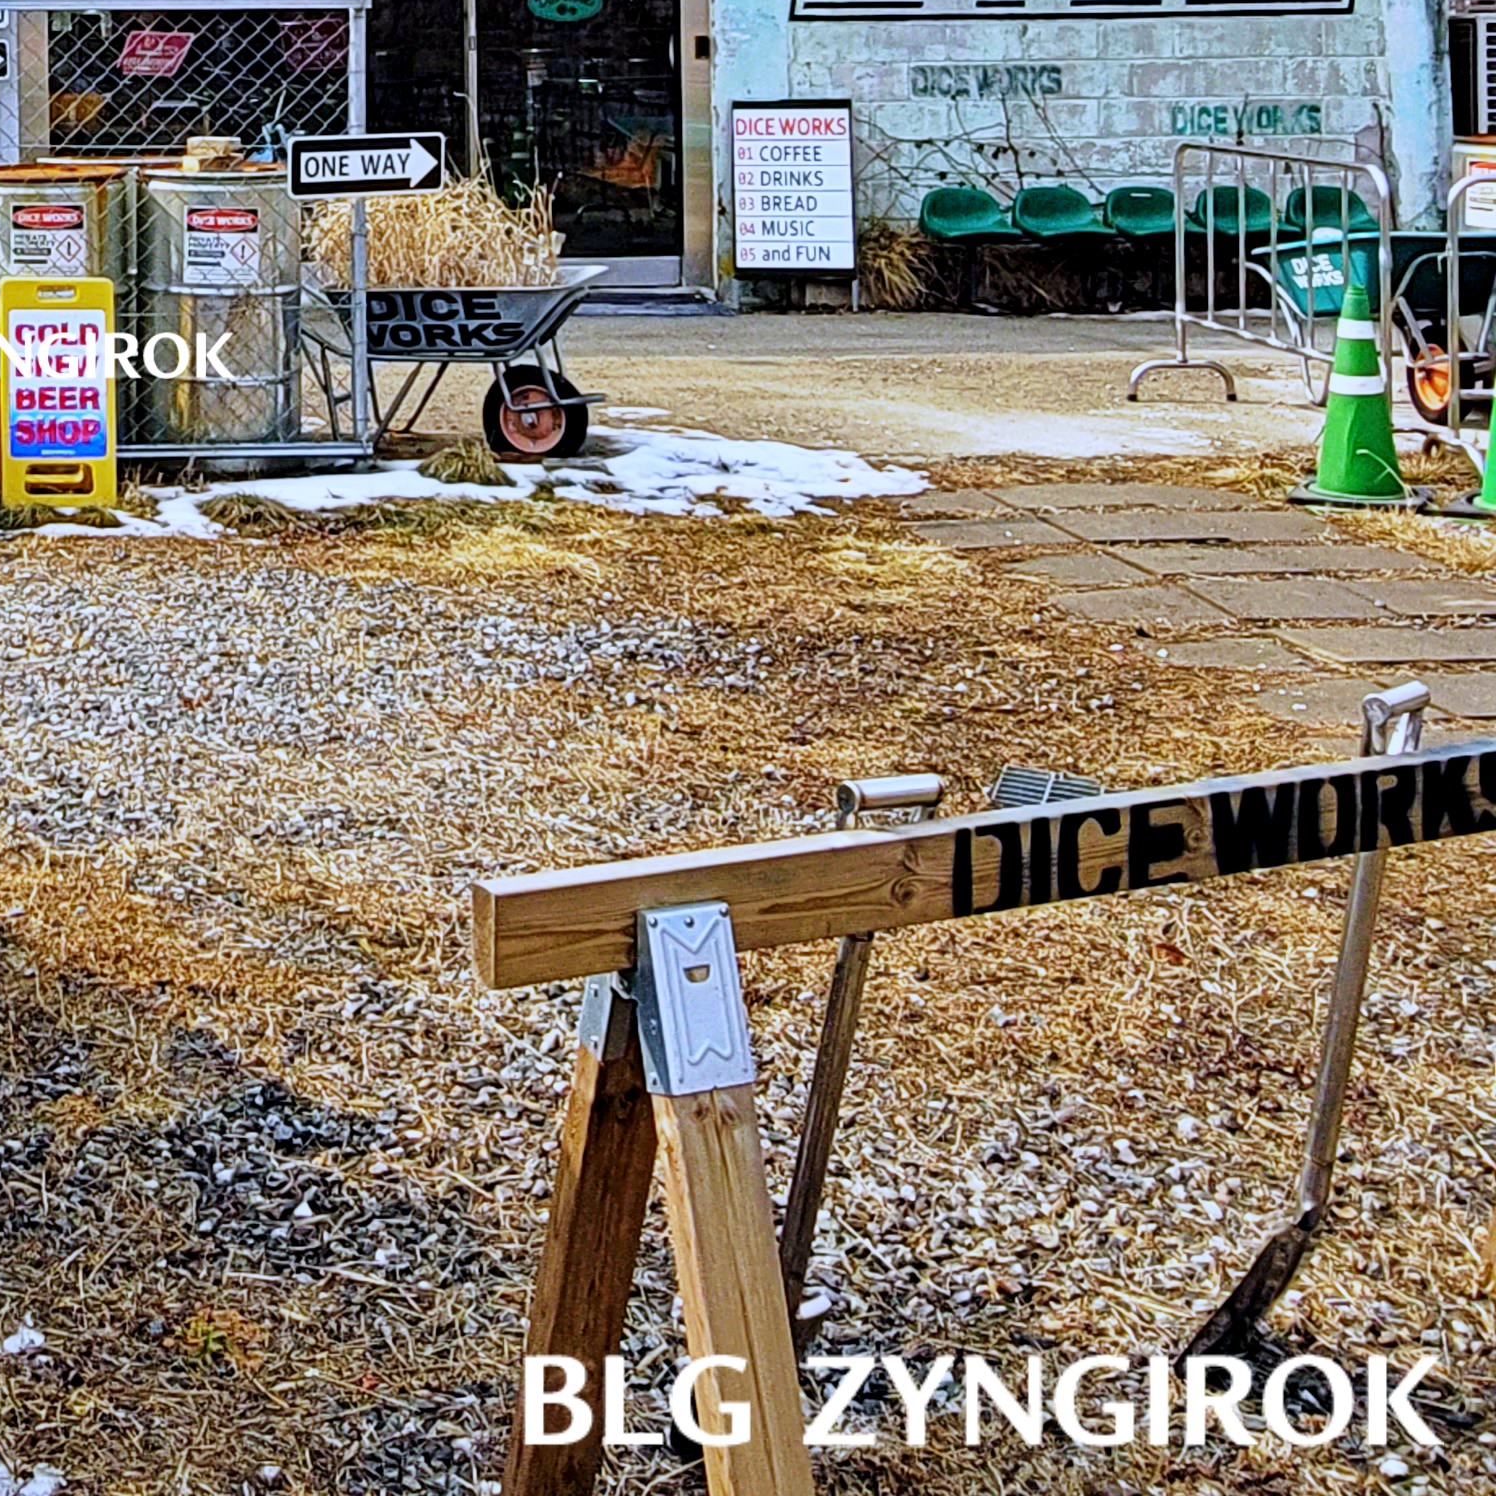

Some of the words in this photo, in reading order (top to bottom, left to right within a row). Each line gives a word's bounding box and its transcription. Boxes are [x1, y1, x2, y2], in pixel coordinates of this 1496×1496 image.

[735, 118, 776, 136] DICE
[779, 117, 847, 136] WORKS
[1171, 104, 1230, 135] DICE
[737, 147, 754, 160] 01
[759, 145, 823, 162] COFFEE
[304, 155, 350, 178] ONE
[361, 153, 411, 176] WAY
[738, 172, 755, 185] 02
[760, 171, 824, 187] DRINKS
[739, 197, 755, 211] 03
[761, 195, 818, 212] BREAD
[739, 222, 756, 236] 04
[761, 220, 816, 237] MUSIC
[740, 247, 756, 261] 05
[762, 245, 791, 261] and
[796, 245, 831, 262] FUN
[366, 291, 502, 322] DICE
[15, 386, 100, 411] BEER
[15, 418, 102, 446] SHOP
[951, 797, 1192, 918] DICE
